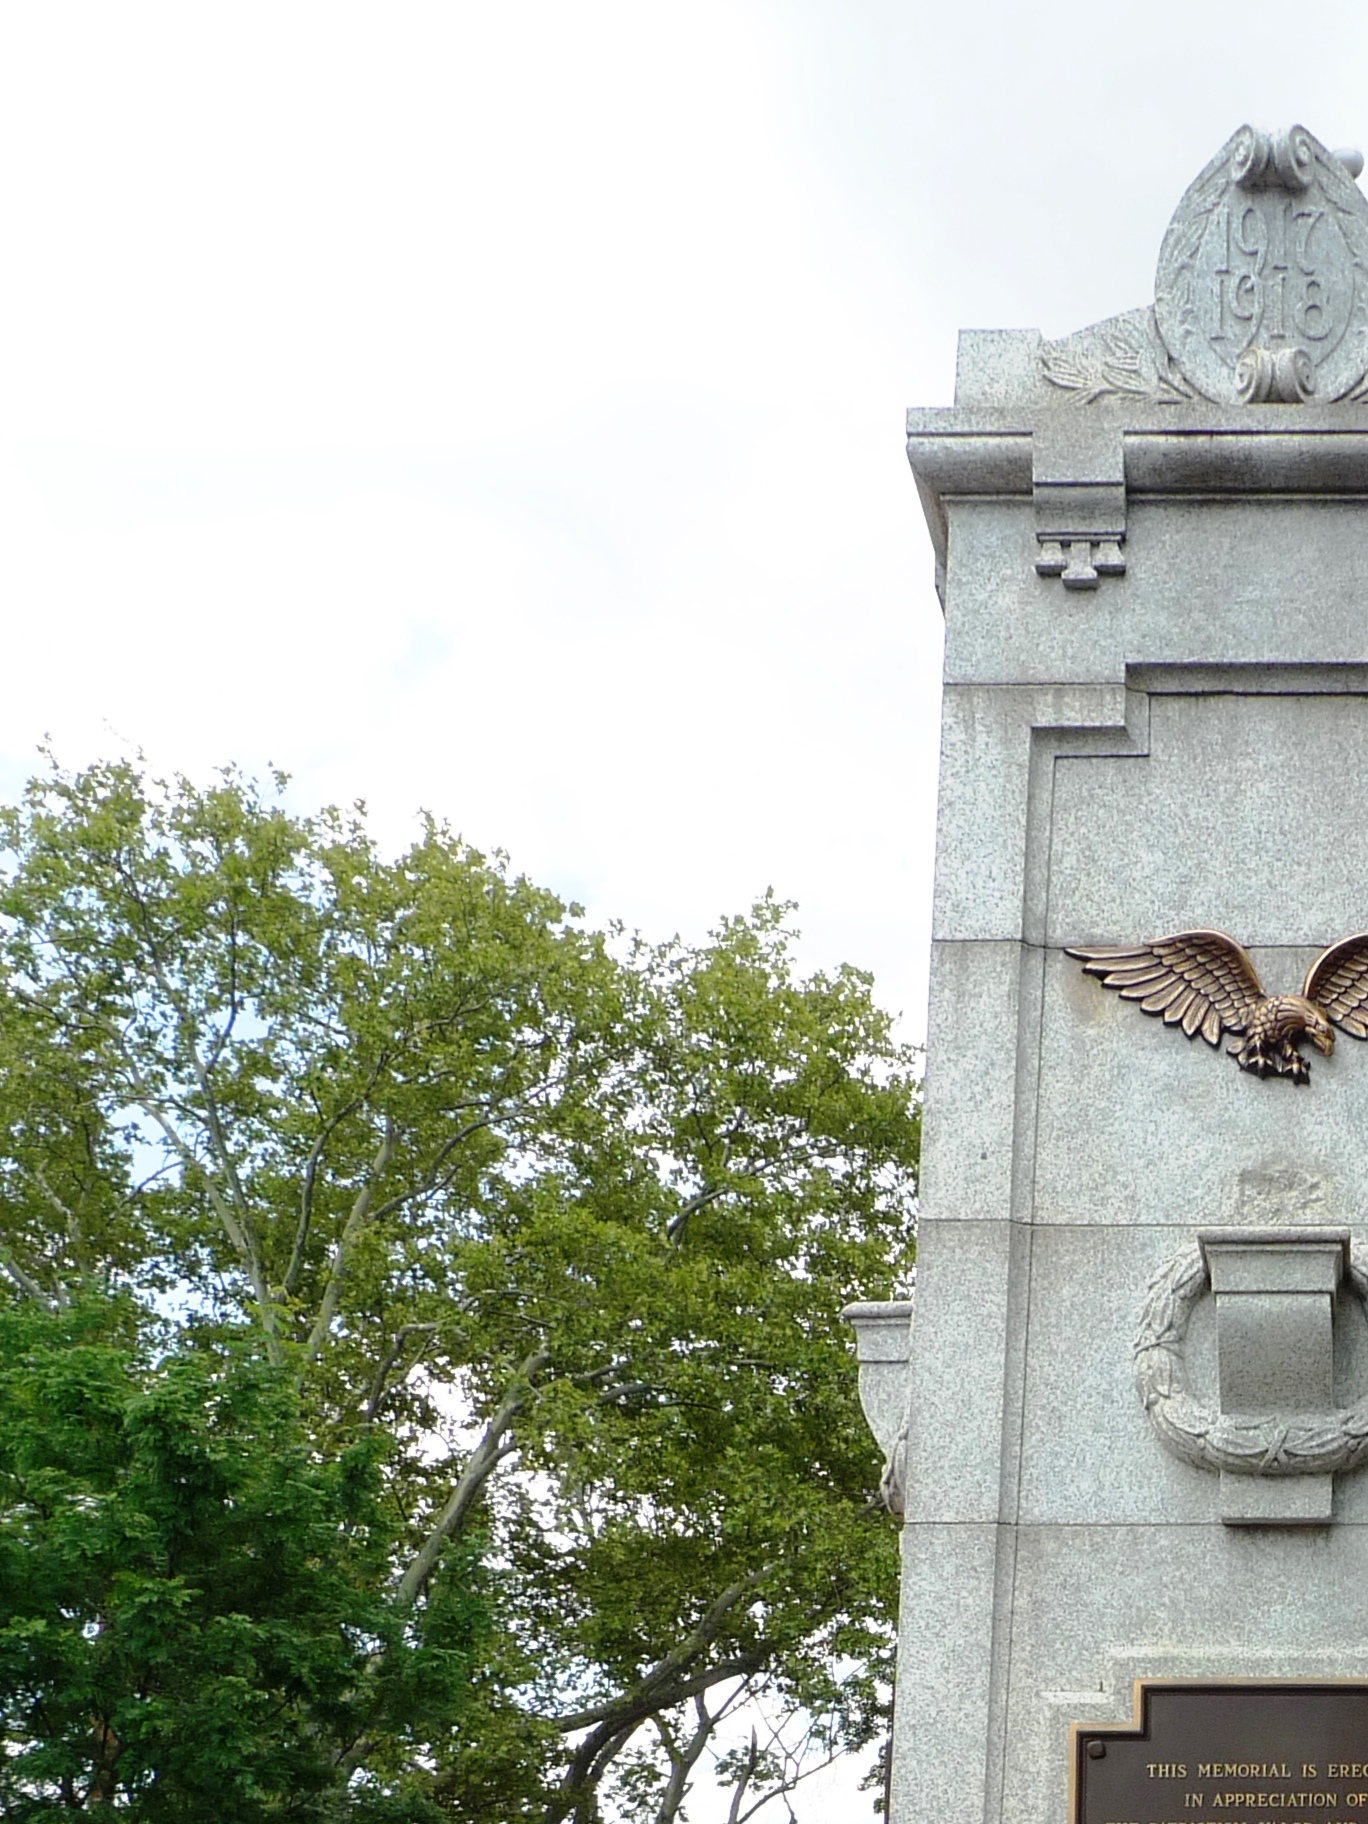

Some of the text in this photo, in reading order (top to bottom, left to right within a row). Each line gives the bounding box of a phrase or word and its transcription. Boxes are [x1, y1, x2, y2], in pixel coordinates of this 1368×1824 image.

[1212, 202, 1325, 275] 1917
[1209, 273, 1333, 342] 1918
[1145, 1763, 1187, 1778] THIS
[1197, 1763, 1292, 1778] MEMORIAL
[1302, 1763, 1317, 1778] IS
[1184, 1792, 1368, 1808] IN APPRECIATION OF
